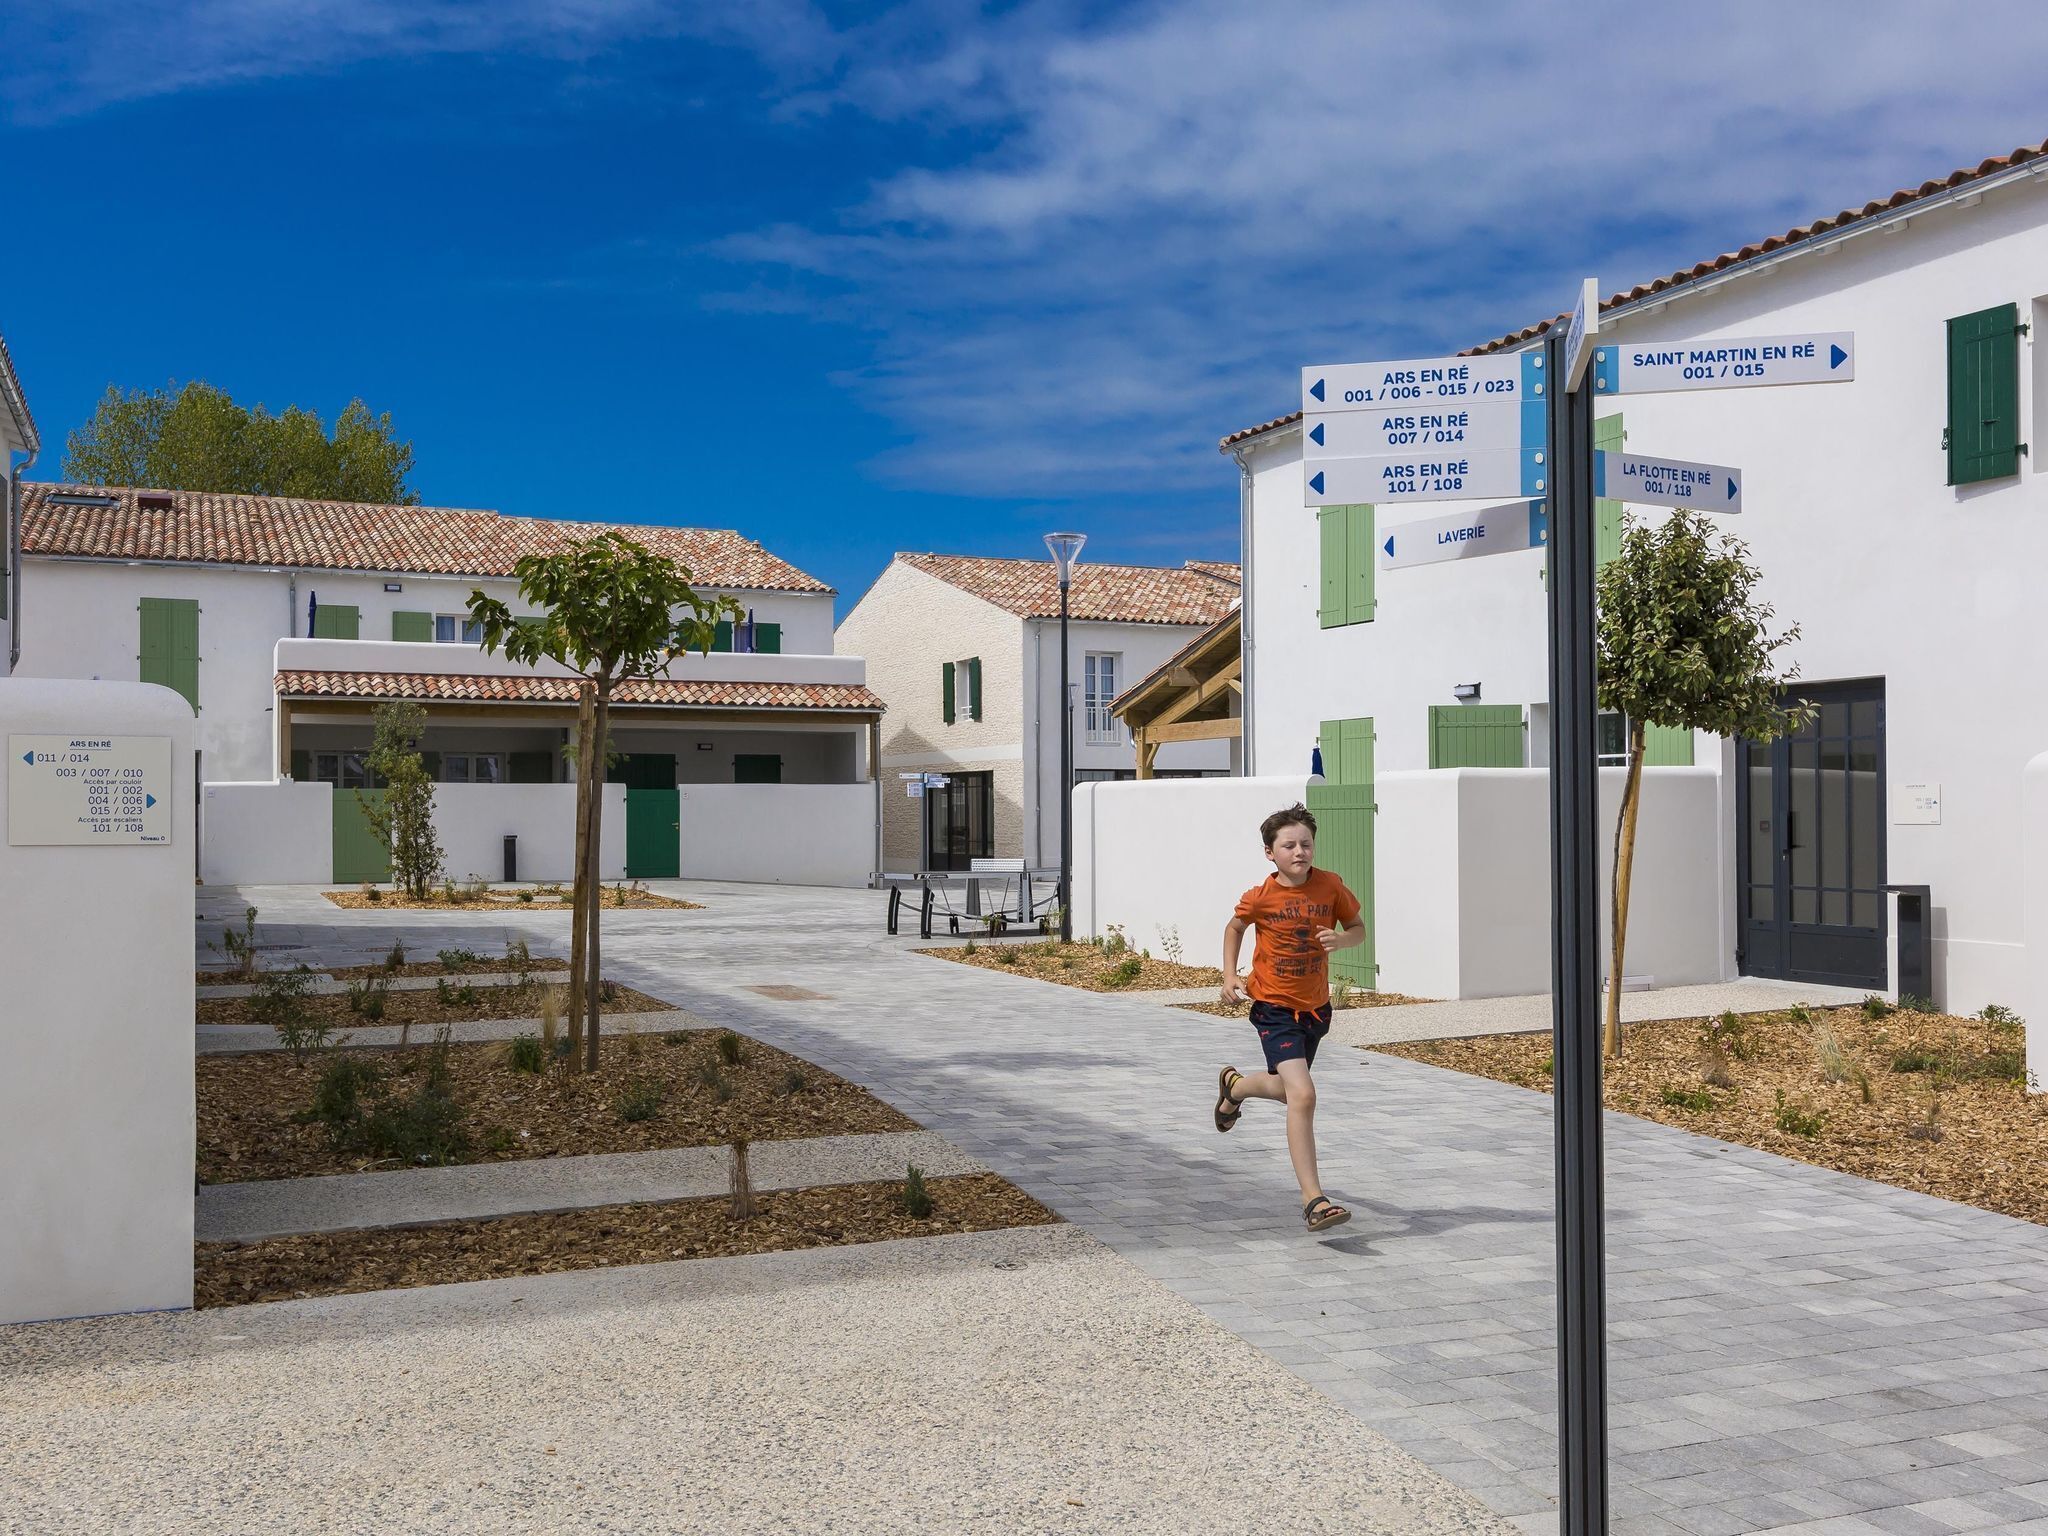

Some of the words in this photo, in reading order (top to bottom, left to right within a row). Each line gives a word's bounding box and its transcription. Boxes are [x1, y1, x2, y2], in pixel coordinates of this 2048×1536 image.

[1633, 352, 1684, 367] SAINT
[1690, 348, 1757, 364] MARTIN
[1762, 346, 1786, 360] EN
[1792, 342, 1815, 358] RÉ
[1383, 372, 1415, 385] ARS
[1421, 370, 1444, 382] EN
[1449, 365, 1469, 380] RÉ
[1683, 366, 1714, 379] 001
[1720, 366, 1727, 377] /
[1734, 364, 1764, 377] 015
[1344, 391, 1373, 402] 001
[1379, 389, 1386, 400] /
[1391, 387, 1420, 399] 006
[1438, 384, 1467, 397] 015
[1473, 382, 1479, 394] /
[1485, 380, 1514, 393] 023
[1383, 418, 1415, 430] ARS
[1421, 416, 1444, 428] EN
[1448, 412, 1468, 426] RÉ
[1388, 432, 1417, 444] 007
[1423, 432, 1430, 443] /
[1435, 430, 1464, 442] 014
[1383, 466, 1415, 478] ARS
[1421, 464, 1444, 476] EN
[1448, 460, 1468, 474] RÉ
[1623, 463, 1636, 476] LA
[1640, 464, 1678, 481] FLOTTE
[1682, 469, 1695, 482] EN
[1698, 470, 1711, 485] RÉ
[1388, 481, 1416, 493] 101
[1422, 480, 1429, 492] /
[1434, 478, 1462, 491] 108
[1645, 482, 1663, 494] 001
[1667, 483, 1672, 495] /
[1674, 484, 1691, 497] 118
[1438, 526, 1485, 545] LAVERIE
[37, 754, 56, 762] 011
[61, 754, 66, 762] /
[70, 754, 89, 762] 014
[56, 769, 76, 777] 003
[81, 769, 86, 777] /
[90, 769, 110, 777] 007
[115, 769, 119, 777] /
[123, 769, 143, 777] 010
[90, 786, 109, 795] 001
[114, 786, 118, 795] /
[123, 786, 143, 795] 002
[88, 796, 108, 804] 004
[113, 796, 118, 804] /
[122, 796, 143, 804] 006
[91, 807, 110, 815] 015
[114, 807, 119, 815] /
[123, 807, 143, 815] 023
[92, 824, 111, 832] 101
[116, 824, 120, 832] /
[125, 824, 144, 832] 108
[1264, 906, 1302, 922] SHARK
